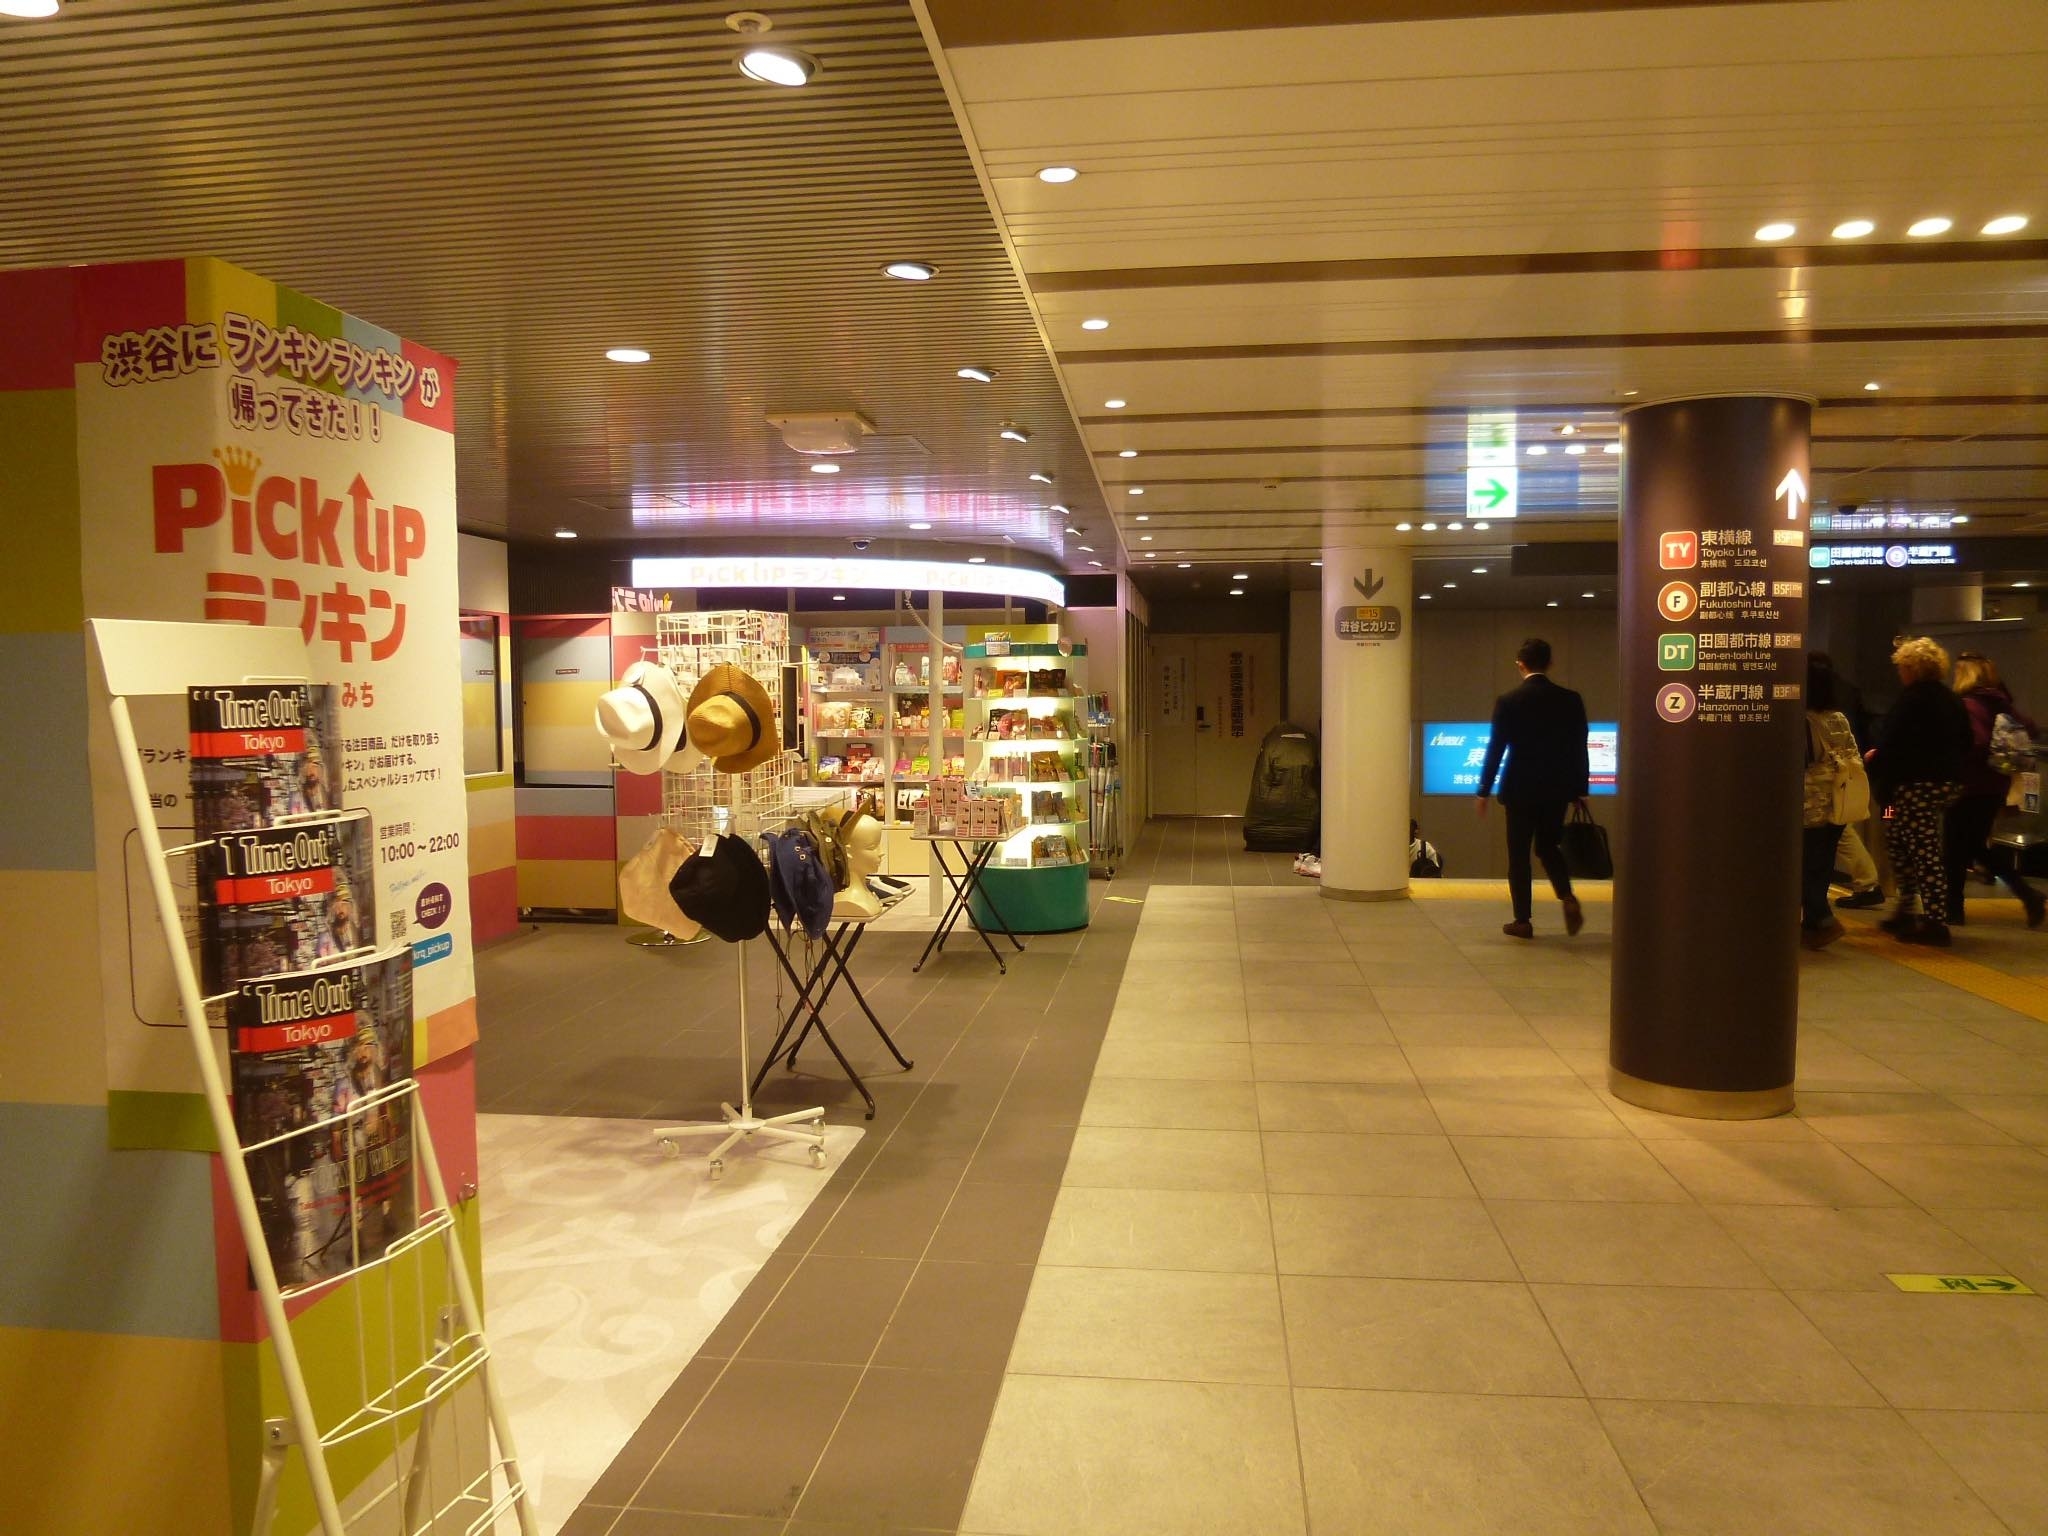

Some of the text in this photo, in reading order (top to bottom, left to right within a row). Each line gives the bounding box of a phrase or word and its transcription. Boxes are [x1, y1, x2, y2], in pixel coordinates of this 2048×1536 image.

[1701, 530, 1752, 546] 東横線
[1666, 542, 1691, 558] TY
[1737, 547, 1757, 557] Line
[1700, 581, 1766, 597] 副都心線
[1673, 596, 1681, 608] F
[1699, 600, 1772, 609] Fukutoshin Line
[1340, 620, 1395, 633] 渋谷ヒカリエ
[1699, 633, 1771, 649] 田園都市線
[1664, 644, 1689, 660] DT
[1698, 651, 1771, 660] Den-en-toshi Line
[1698, 684, 1764, 700] 半蔵門線
[1670, 696, 1680, 709] Z
[1751, 702, 1769, 711] Line
[240, 734, 285, 752] Tokyo
[266, 877, 313, 895] Tokyo
[282, 1024, 332, 1043] Tokyo
